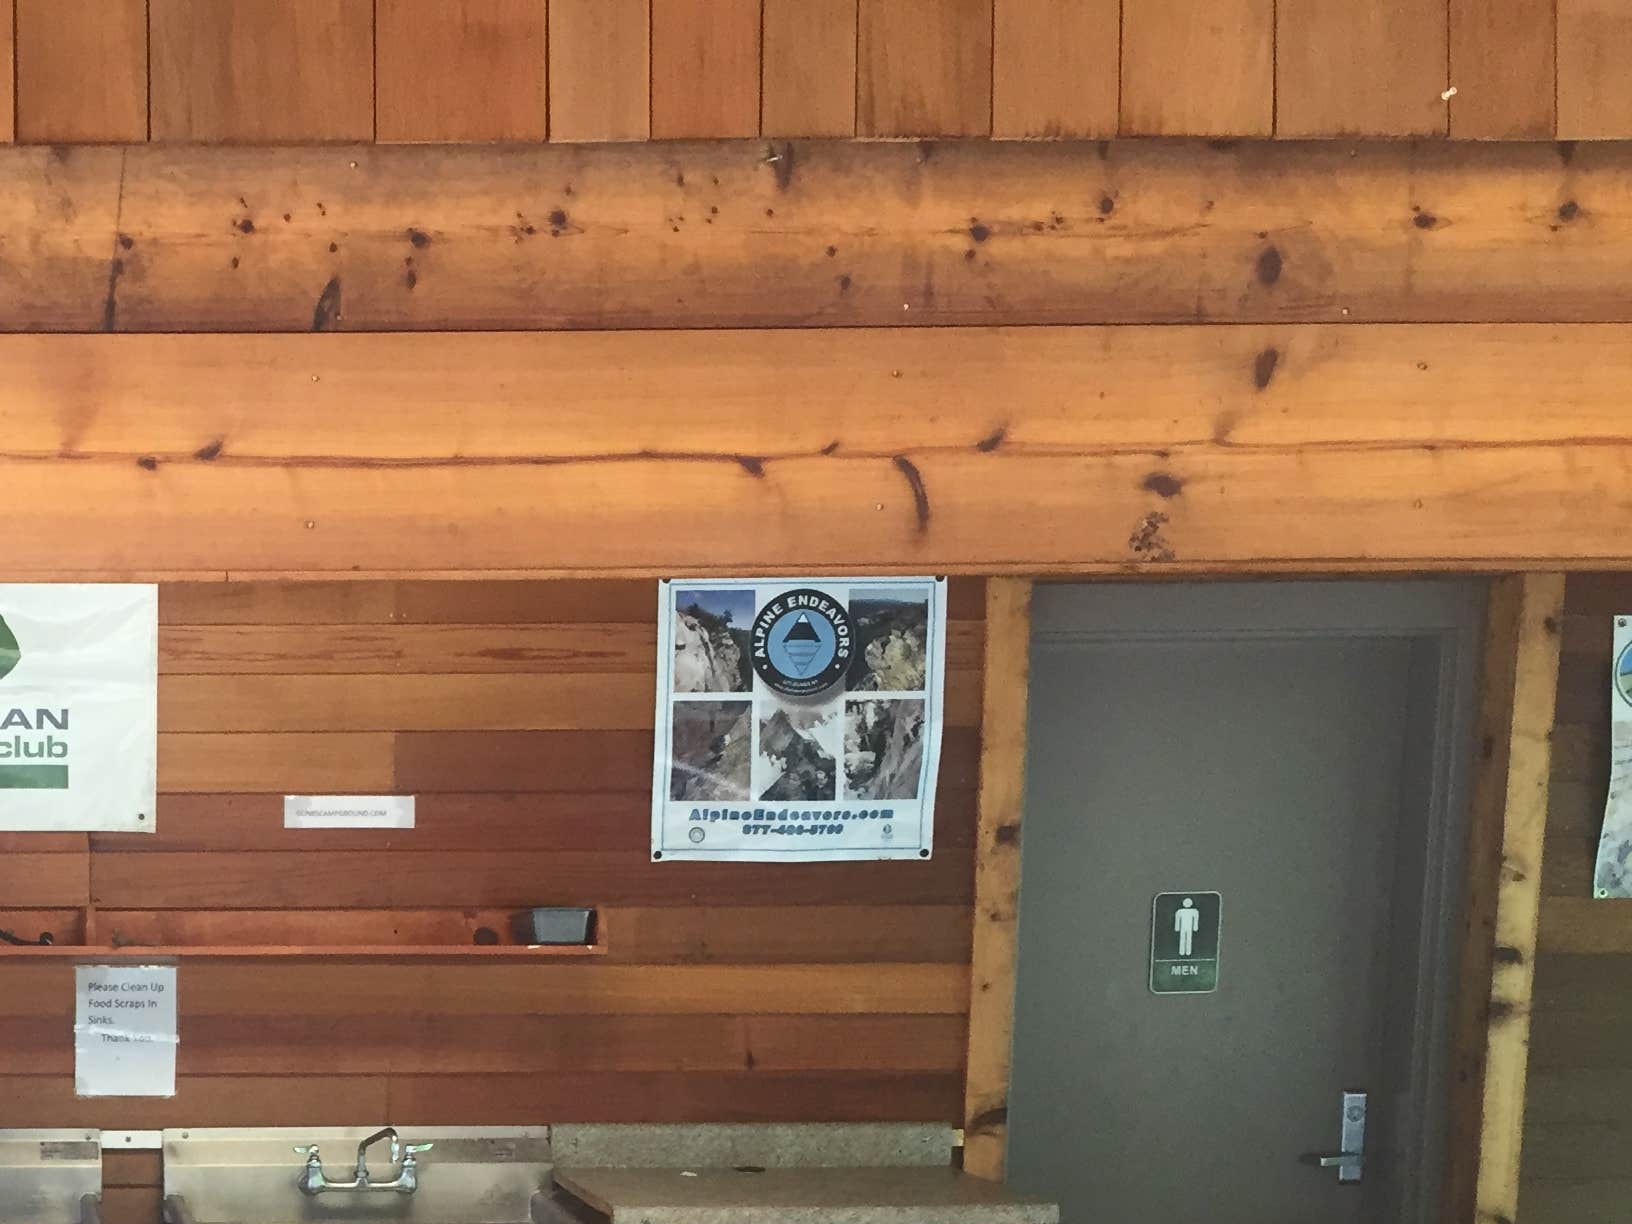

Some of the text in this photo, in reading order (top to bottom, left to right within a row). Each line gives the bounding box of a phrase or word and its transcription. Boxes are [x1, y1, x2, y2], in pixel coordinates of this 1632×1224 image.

[754, 595, 850, 659] ALPINE ENDEAVORS
[689, 808, 894, 822] AlpineEndeavors.com
[1171, 965, 1199, 976] MEN
[88, 982, 165, 993] Please Clean Up
[88, 999, 112, 1008] Food
[114, 999, 145, 1010] Scraps
